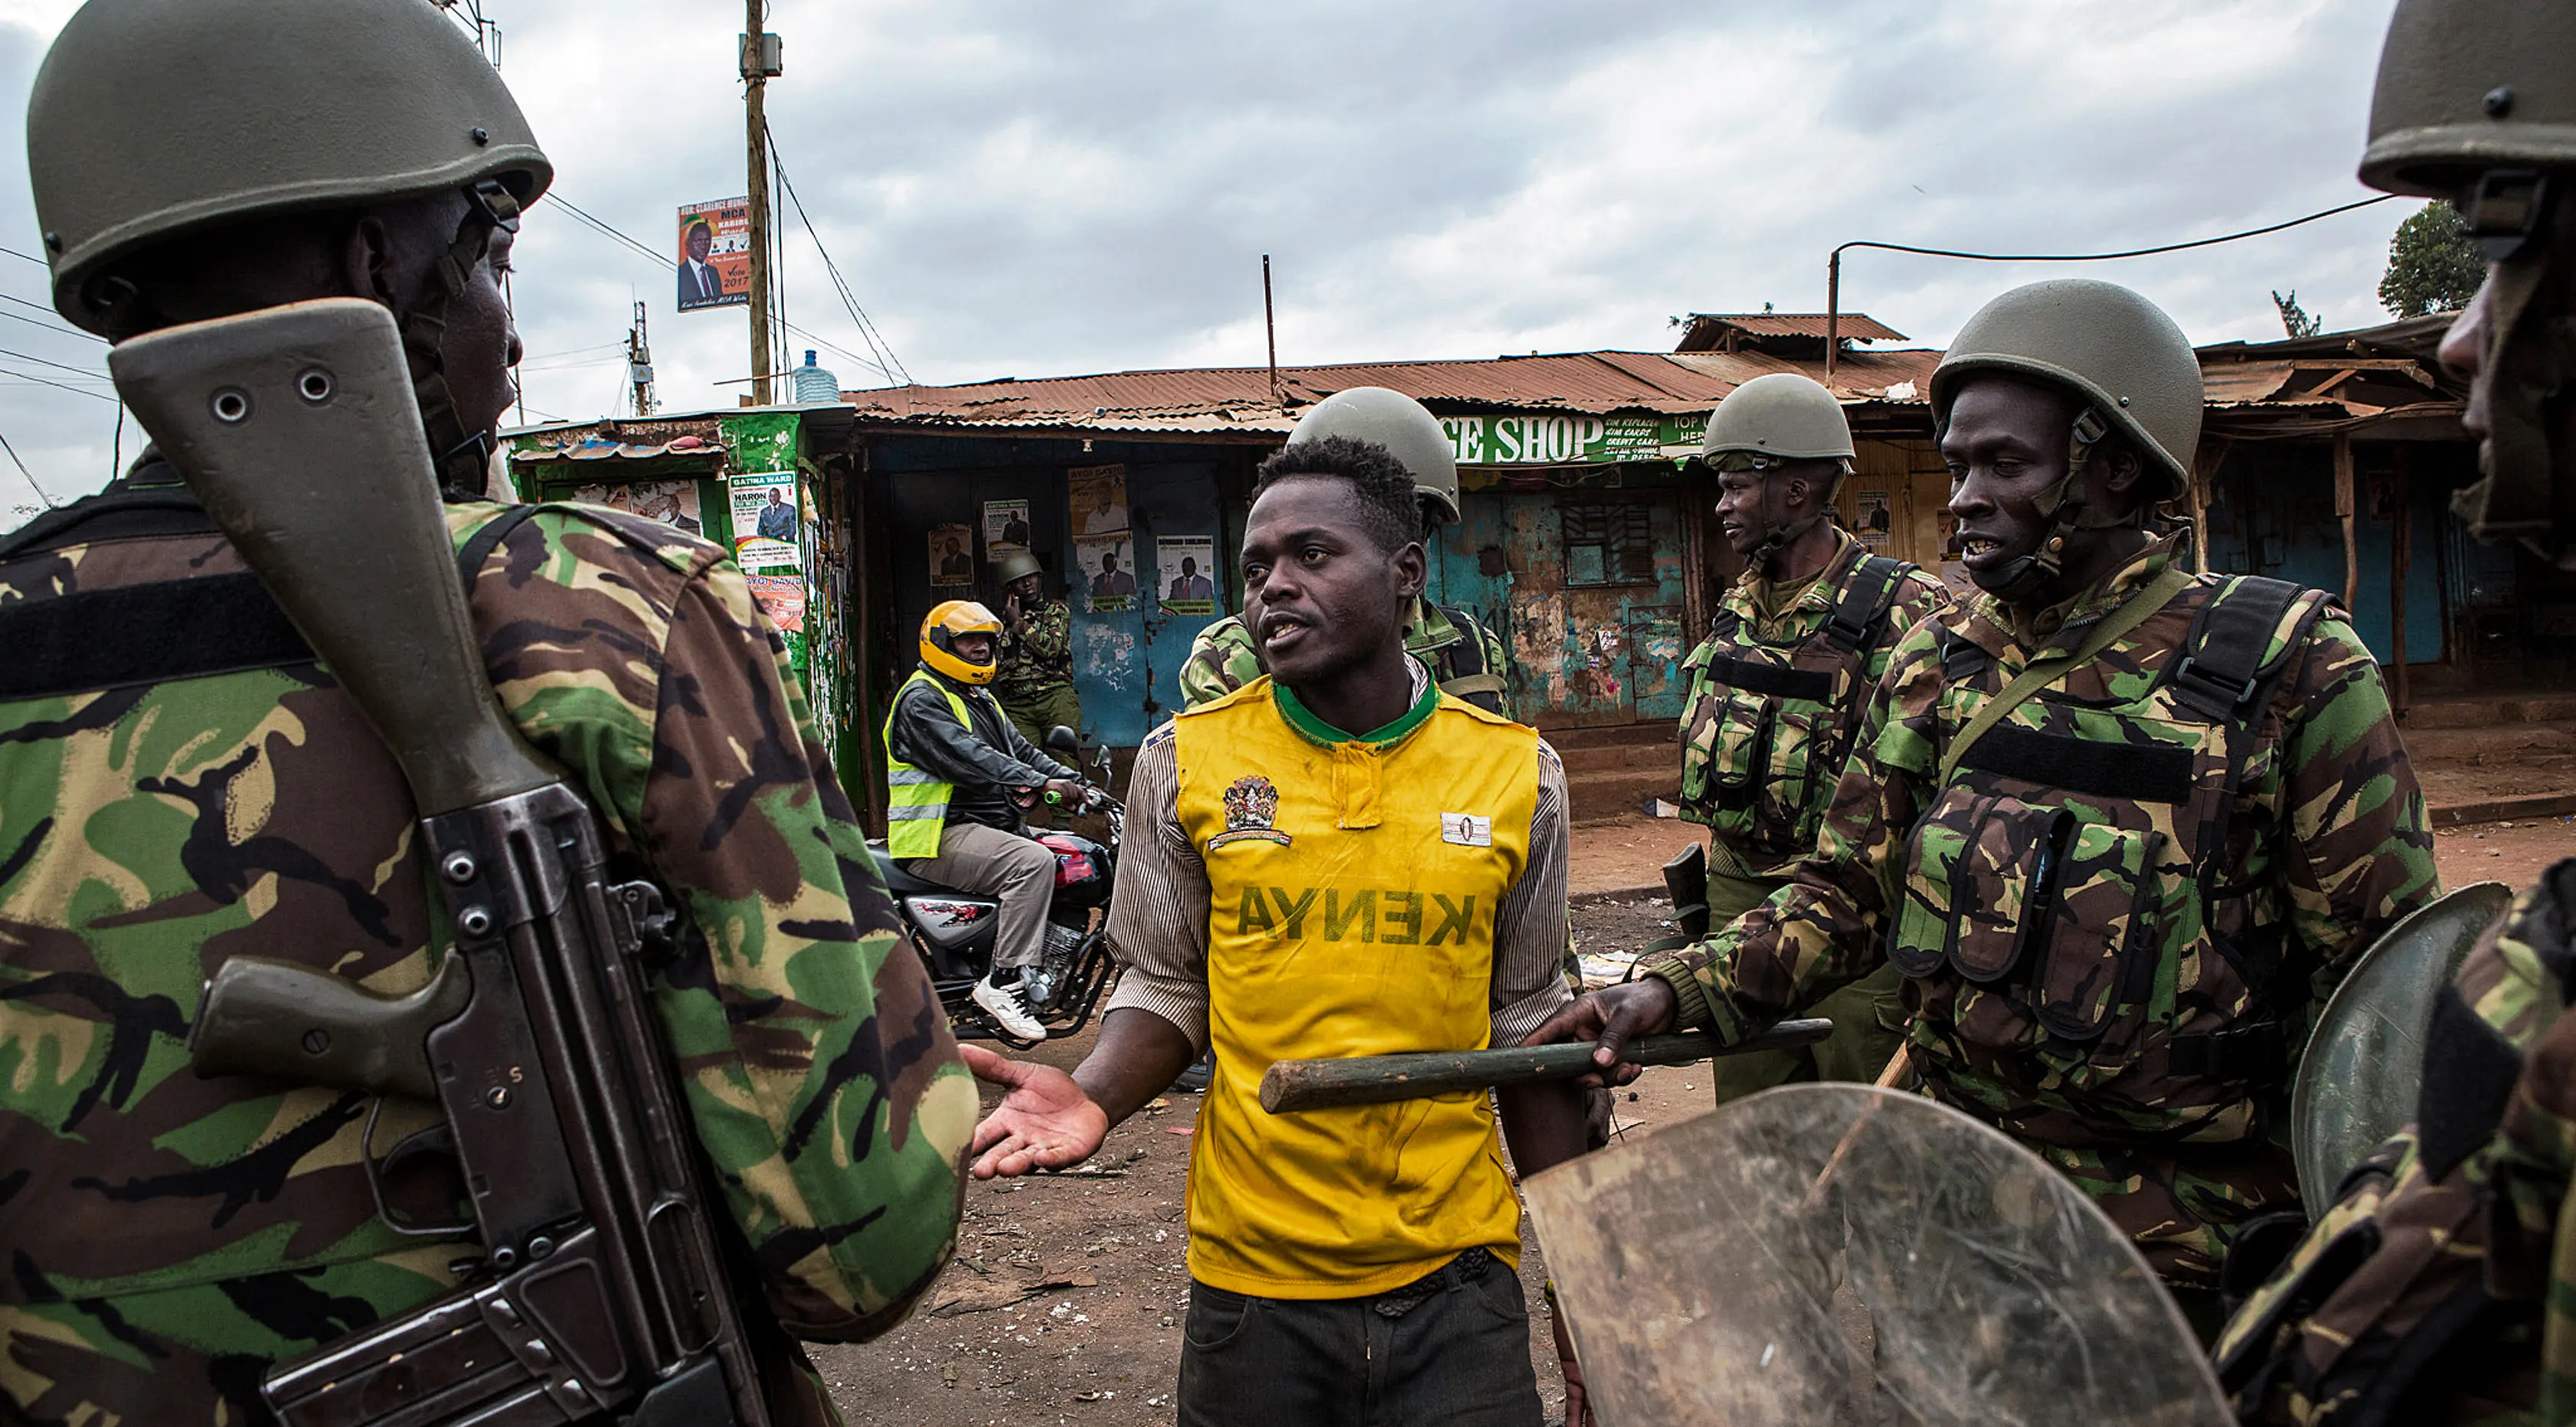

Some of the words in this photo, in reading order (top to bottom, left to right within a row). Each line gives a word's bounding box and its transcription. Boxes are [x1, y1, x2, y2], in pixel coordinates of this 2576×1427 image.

[721, 208, 745, 220] MCA
[724, 276, 749, 288] 2017
[1673, 416, 1698, 429] TOP
[1605, 427, 1623, 436] SIM
[1624, 428, 1652, 436] CARDS
[1495, 416, 1603, 462] SHOP
[734, 477, 765, 485] GATINA
[767, 475, 792, 483] WARD
[734, 492, 767, 501] HARON
